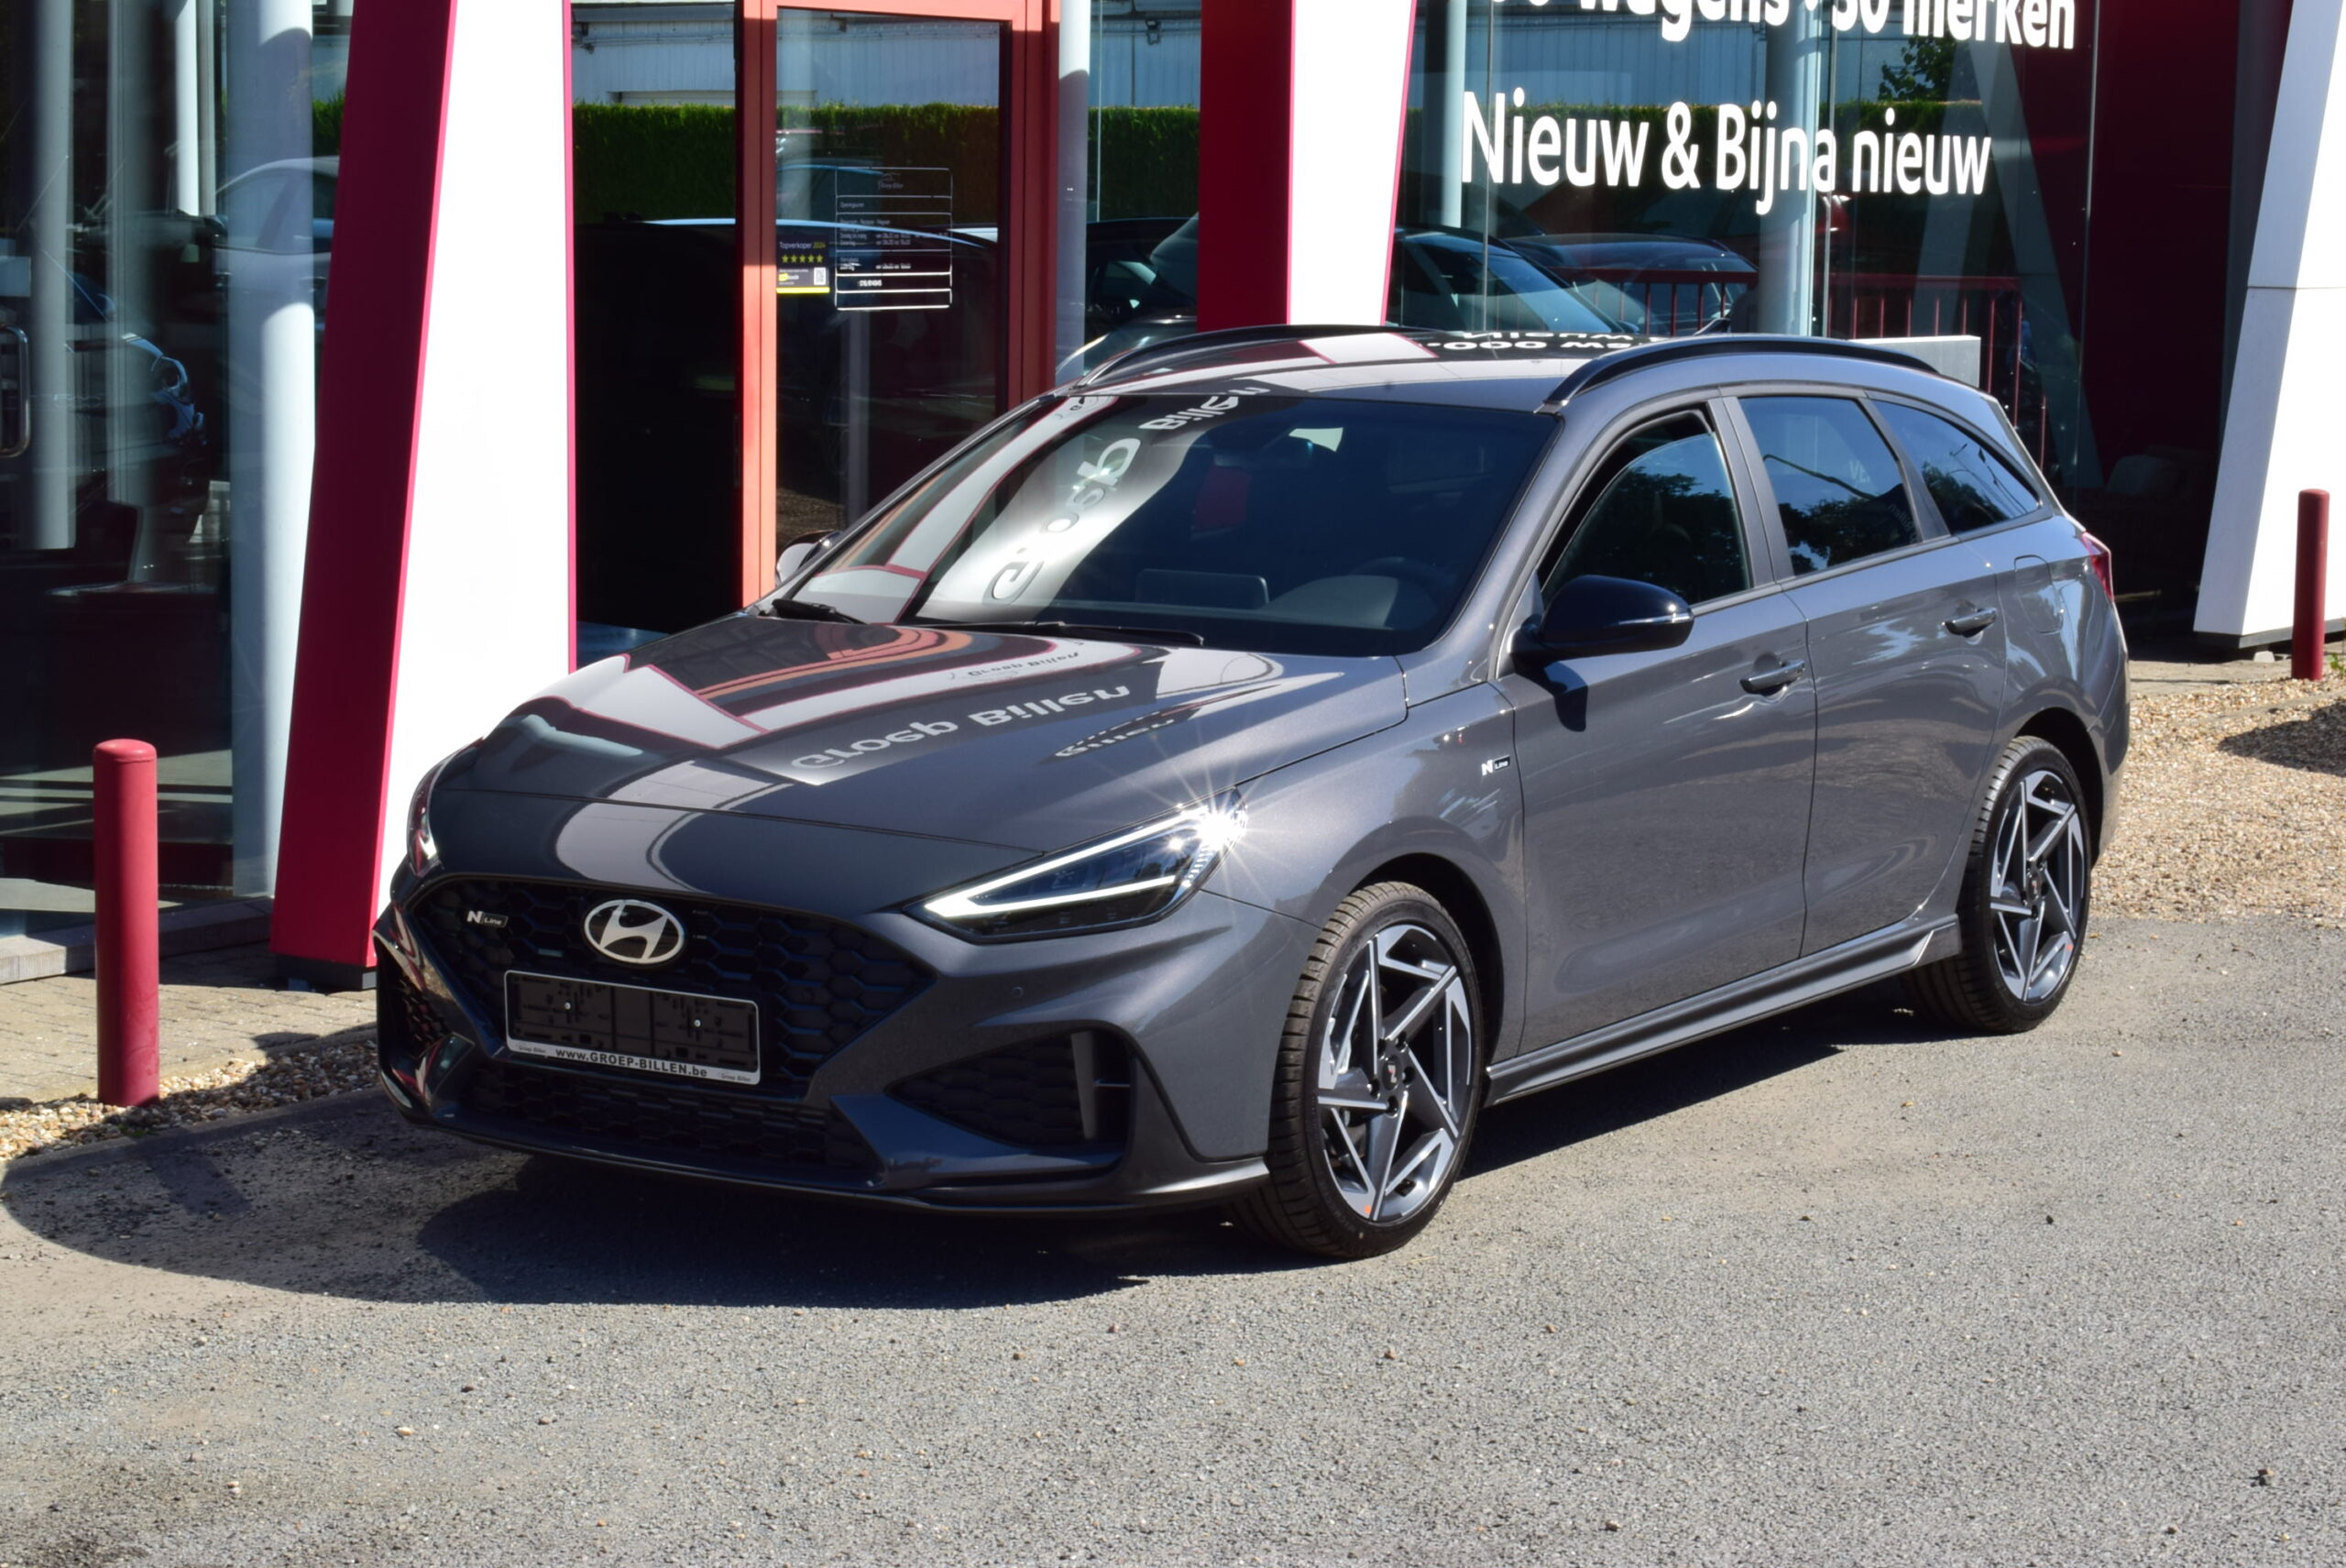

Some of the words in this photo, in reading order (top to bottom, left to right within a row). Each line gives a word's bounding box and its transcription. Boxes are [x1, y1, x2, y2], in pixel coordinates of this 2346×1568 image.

[1461, 87, 1650, 187] Nieuw
[1661, 101, 1702, 190] &
[1716, 100, 1837, 216] Bijna
[1852, 107, 1991, 195] nieuw
[1481, 759, 1494, 776] N
[466, 910, 483, 924] N
[555, 1047, 707, 1078] www.GROEP-BILLEN.be
